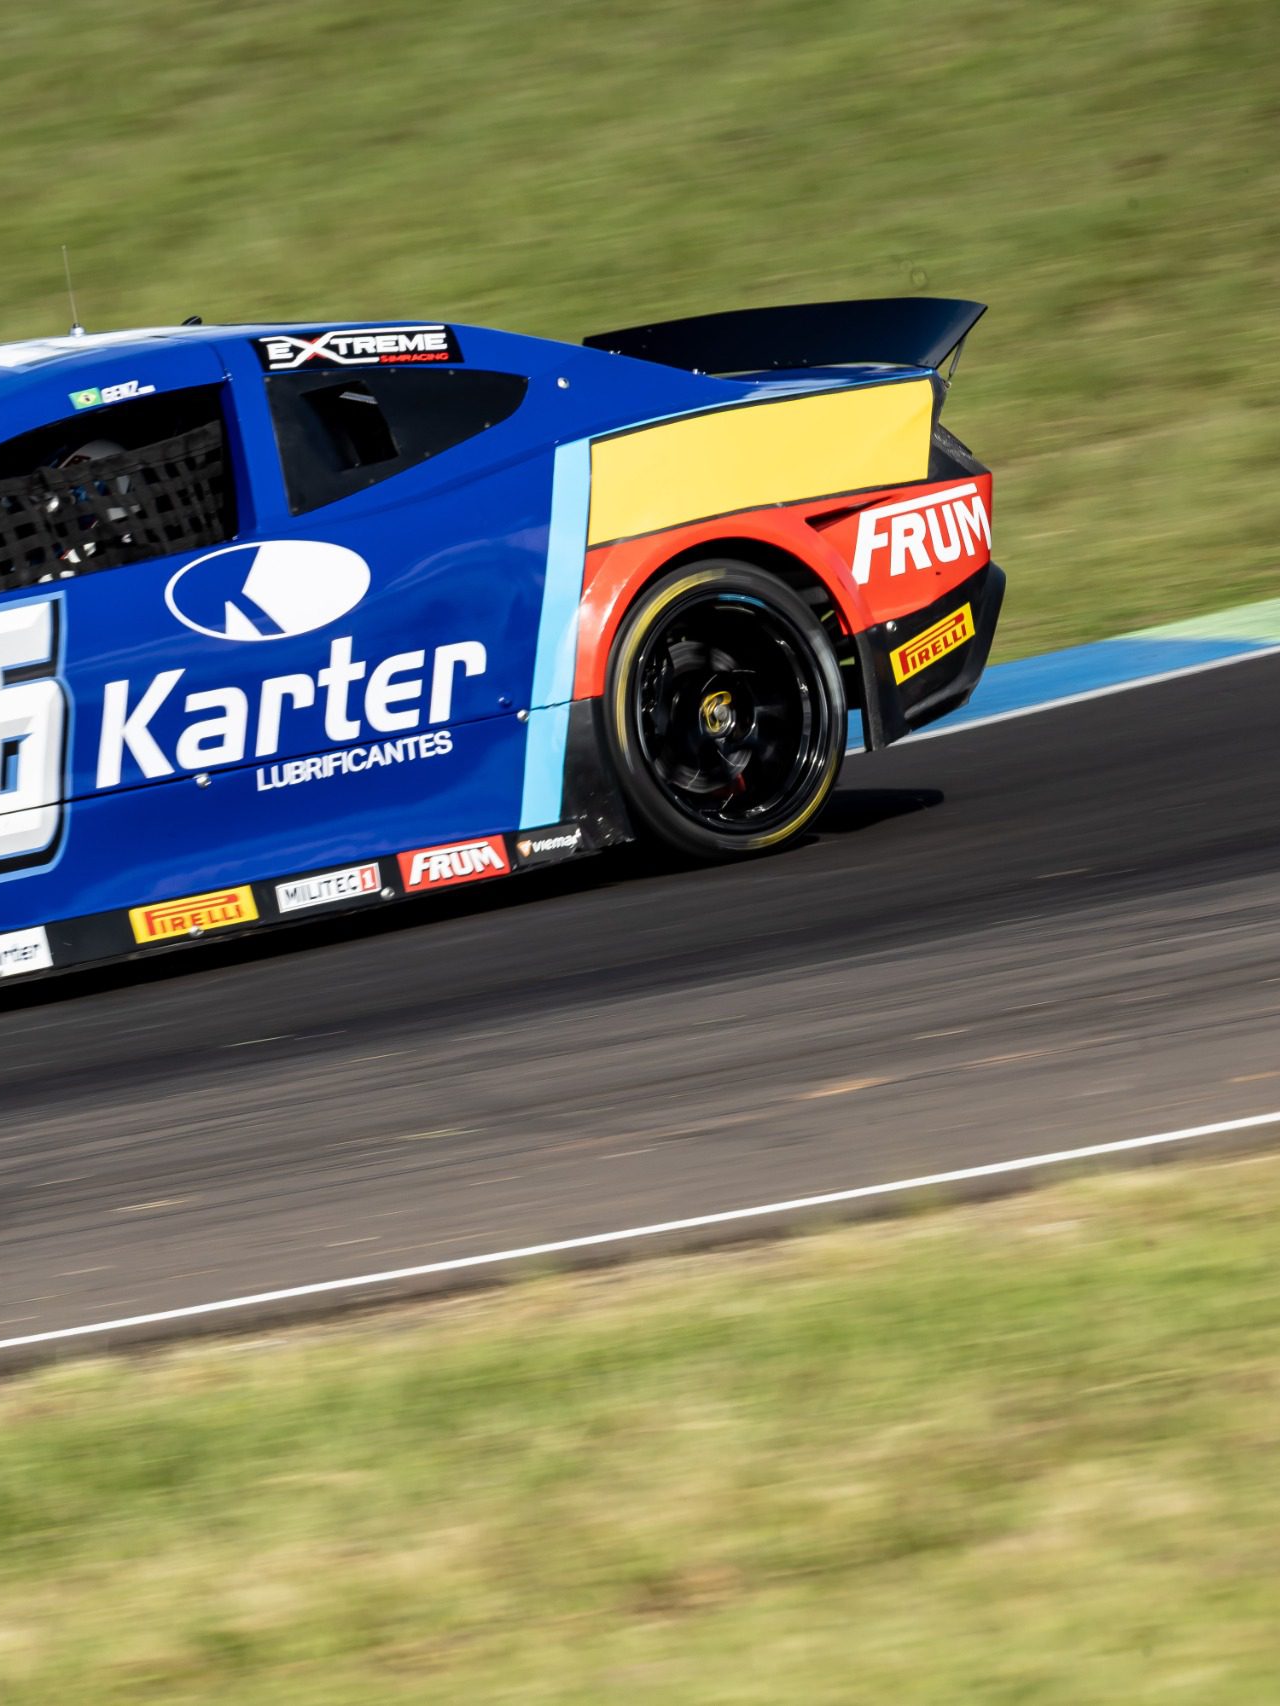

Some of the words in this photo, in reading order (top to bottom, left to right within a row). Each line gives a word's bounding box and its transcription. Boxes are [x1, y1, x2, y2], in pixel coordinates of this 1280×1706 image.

[259, 325, 448, 370] EXTREME
[379, 352, 449, 364] SIMRACING
[851, 483, 992, 585] FRUM
[898, 612, 965, 676] PIRELLI
[96, 637, 486, 788] Karter
[256, 730, 453, 791] LUBRIFICANTES
[409, 841, 504, 885] FRUM
[144, 893, 244, 936] PIRELLI
